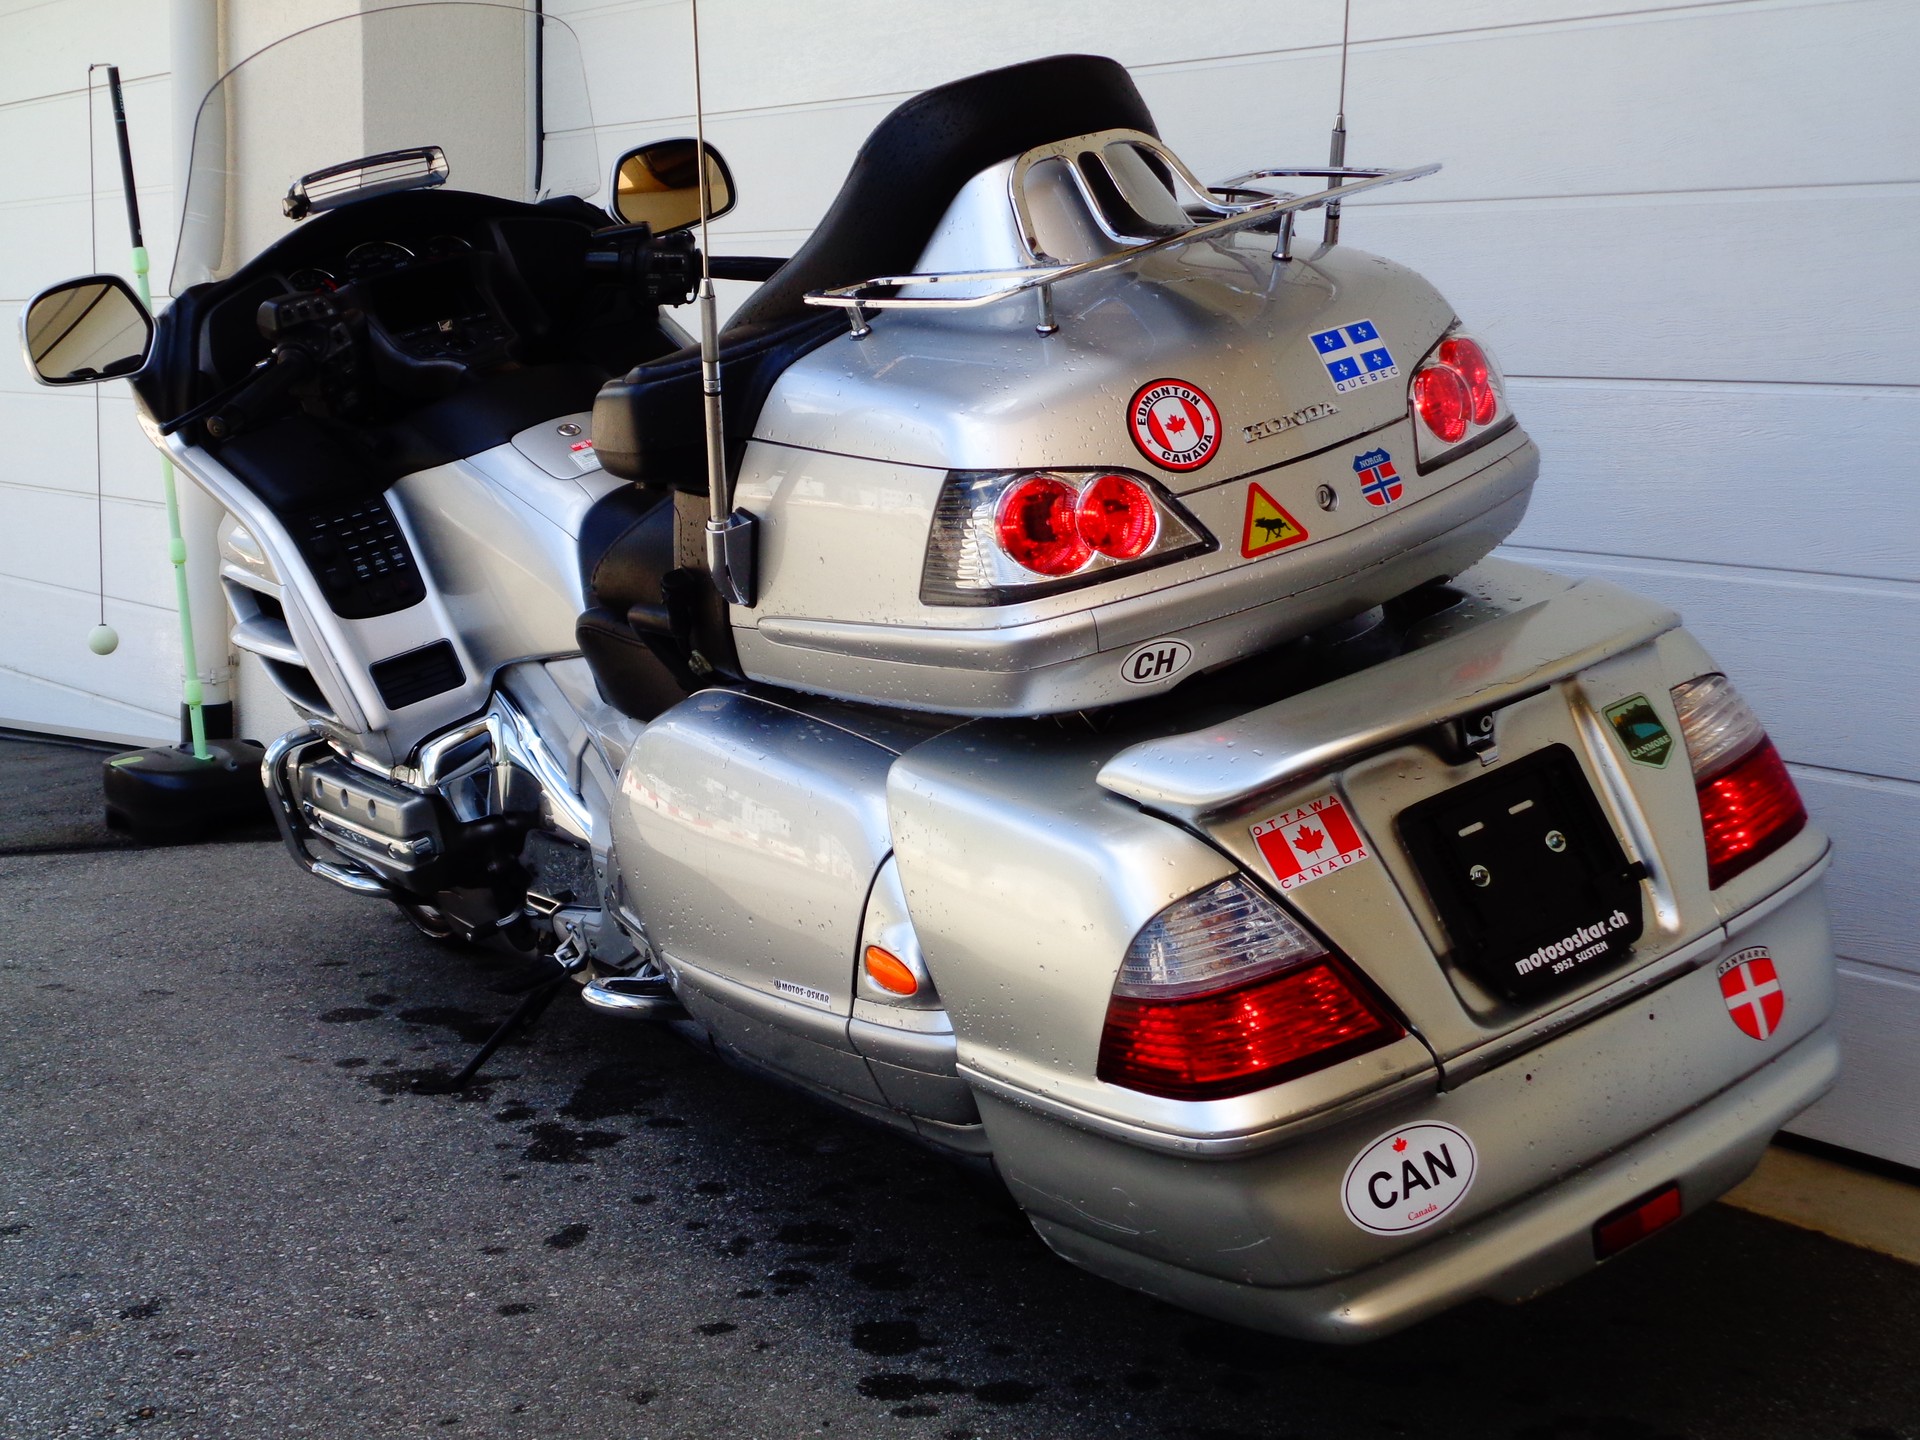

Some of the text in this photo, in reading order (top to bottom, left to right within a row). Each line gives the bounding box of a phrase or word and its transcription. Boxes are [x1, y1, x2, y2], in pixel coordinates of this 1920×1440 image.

[1337, 366, 1398, 391] QUEBEC
[1138, 386, 1200, 426] EDMONTON
[1242, 402, 1341, 443] HONDA
[1162, 434, 1213, 463] CANADA
[1359, 454, 1384, 469] NORGE
[1134, 647, 1177, 680] CH
[1631, 734, 1671, 757] CANMORE
[1253, 795, 1338, 836] OTTAWA
[1281, 849, 1367, 889] CANADA
[1514, 909, 1629, 976] motososkar.ch
[1551, 940, 1609, 975] 3952 SUSTEN
[1718, 949, 1768, 974] DANMARK
[781, 982, 830, 1004] MOTOS-OSKAR
[1368, 1143, 1457, 1210] CAN
[1407, 1203, 1438, 1221] Canada
